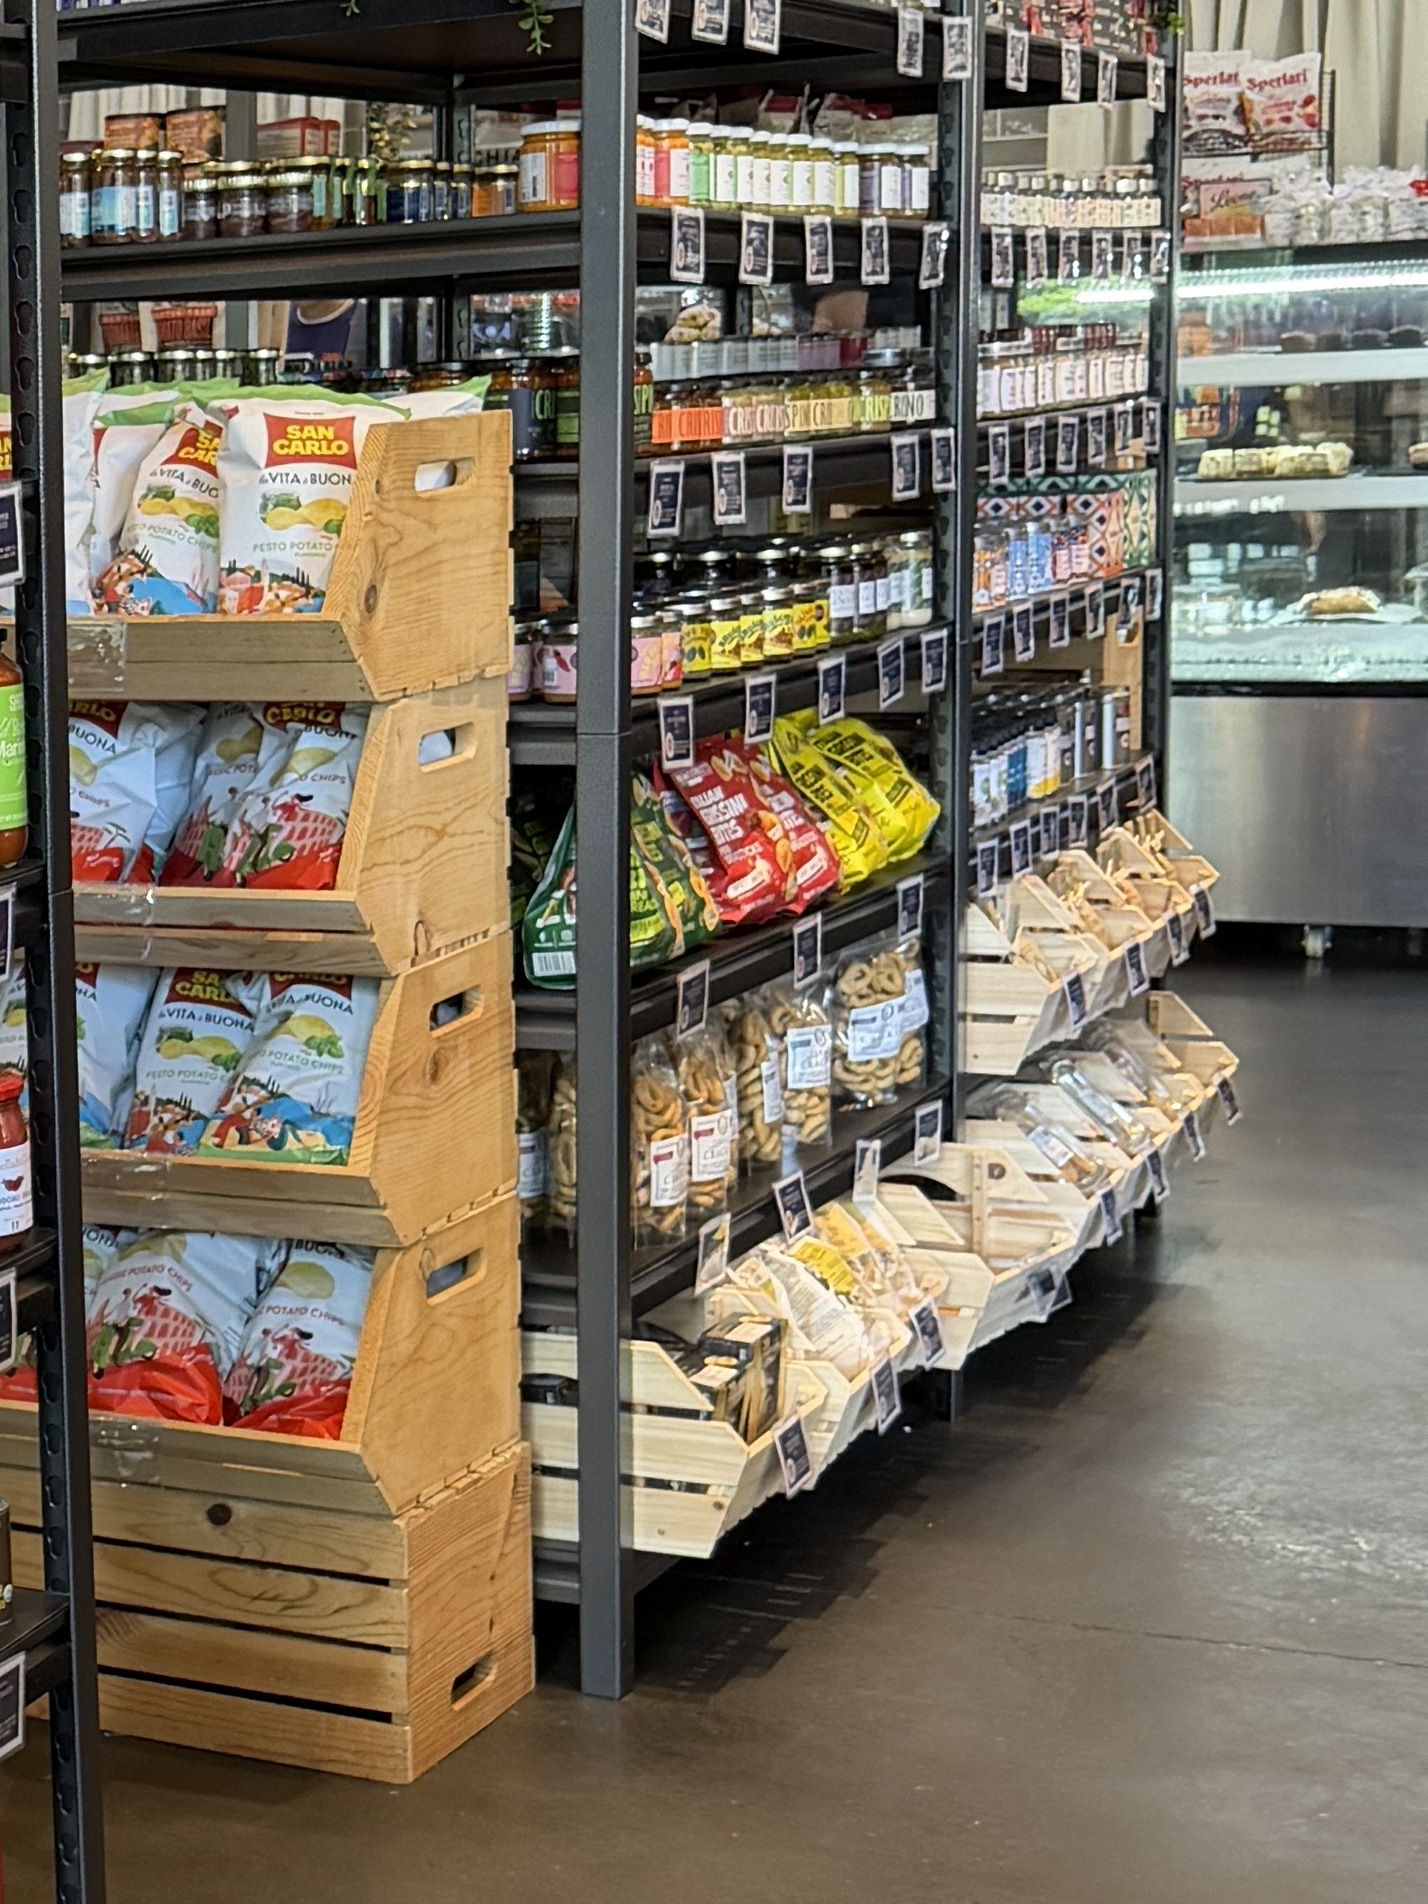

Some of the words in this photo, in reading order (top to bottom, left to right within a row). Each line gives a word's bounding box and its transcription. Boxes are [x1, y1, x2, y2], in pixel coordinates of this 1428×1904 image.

[286, 425, 334, 440] SAN
[273, 439, 349, 456] CARLO
[269, 473, 301, 484] VITA
[311, 473, 352, 485] BUON
[253, 543, 286, 552] PESTO
[290, 542, 332, 552] POTATO
